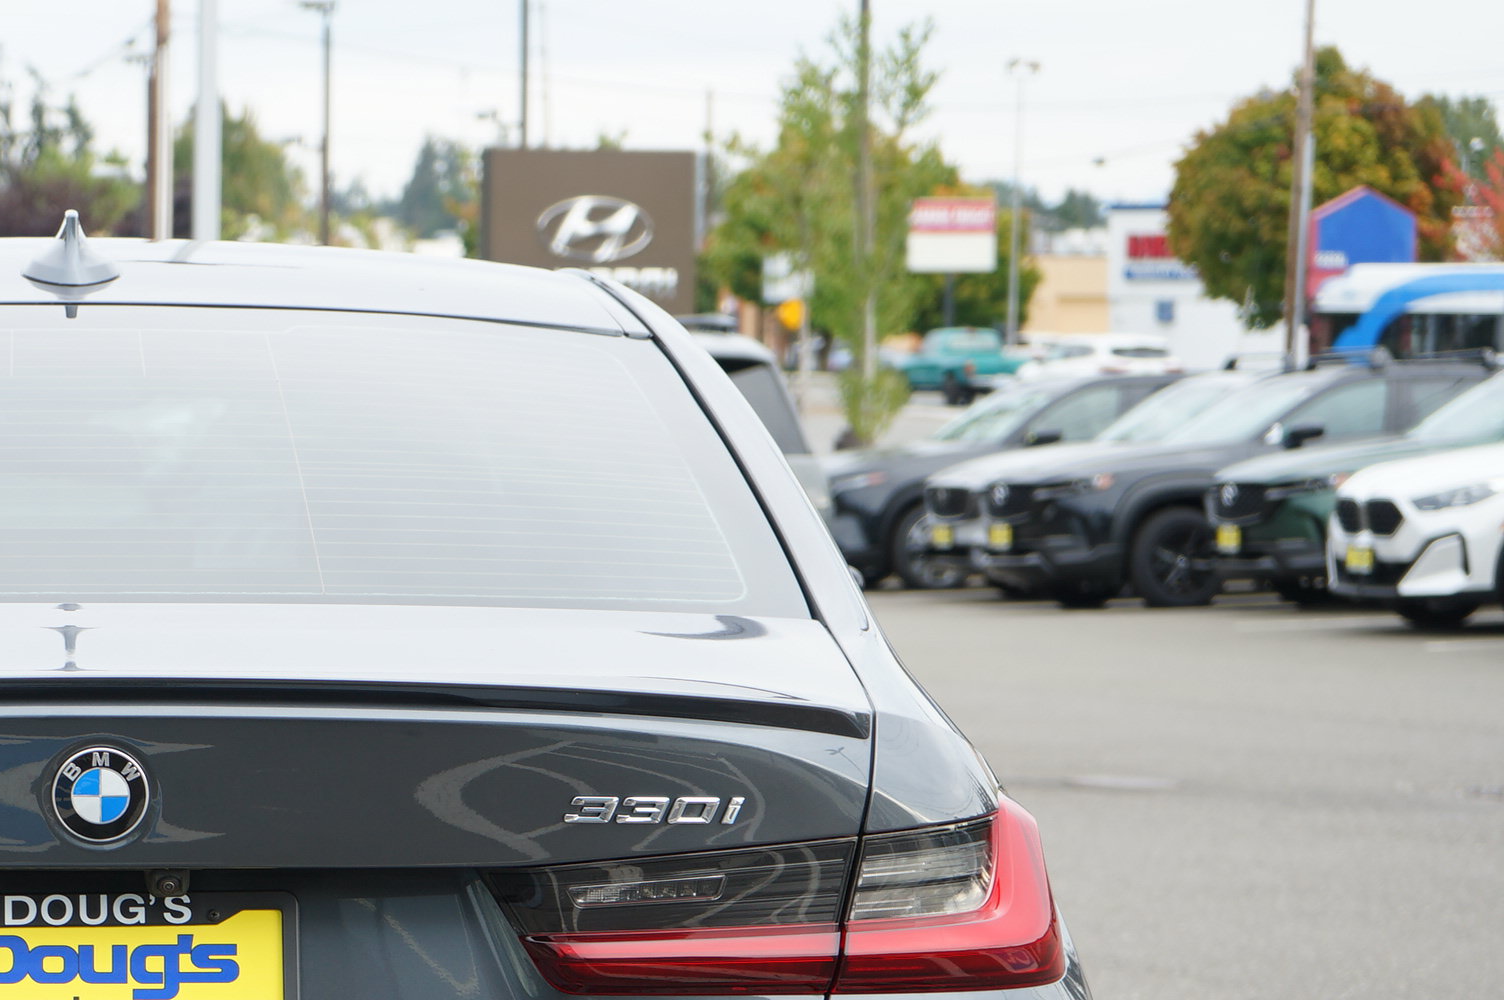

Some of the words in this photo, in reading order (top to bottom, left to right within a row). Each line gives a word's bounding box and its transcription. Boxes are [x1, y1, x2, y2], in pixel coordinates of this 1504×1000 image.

[62, 752, 141, 781] BMW
[563, 796, 746, 825] 330i
[3, 894, 192, 926] DOUG'S
